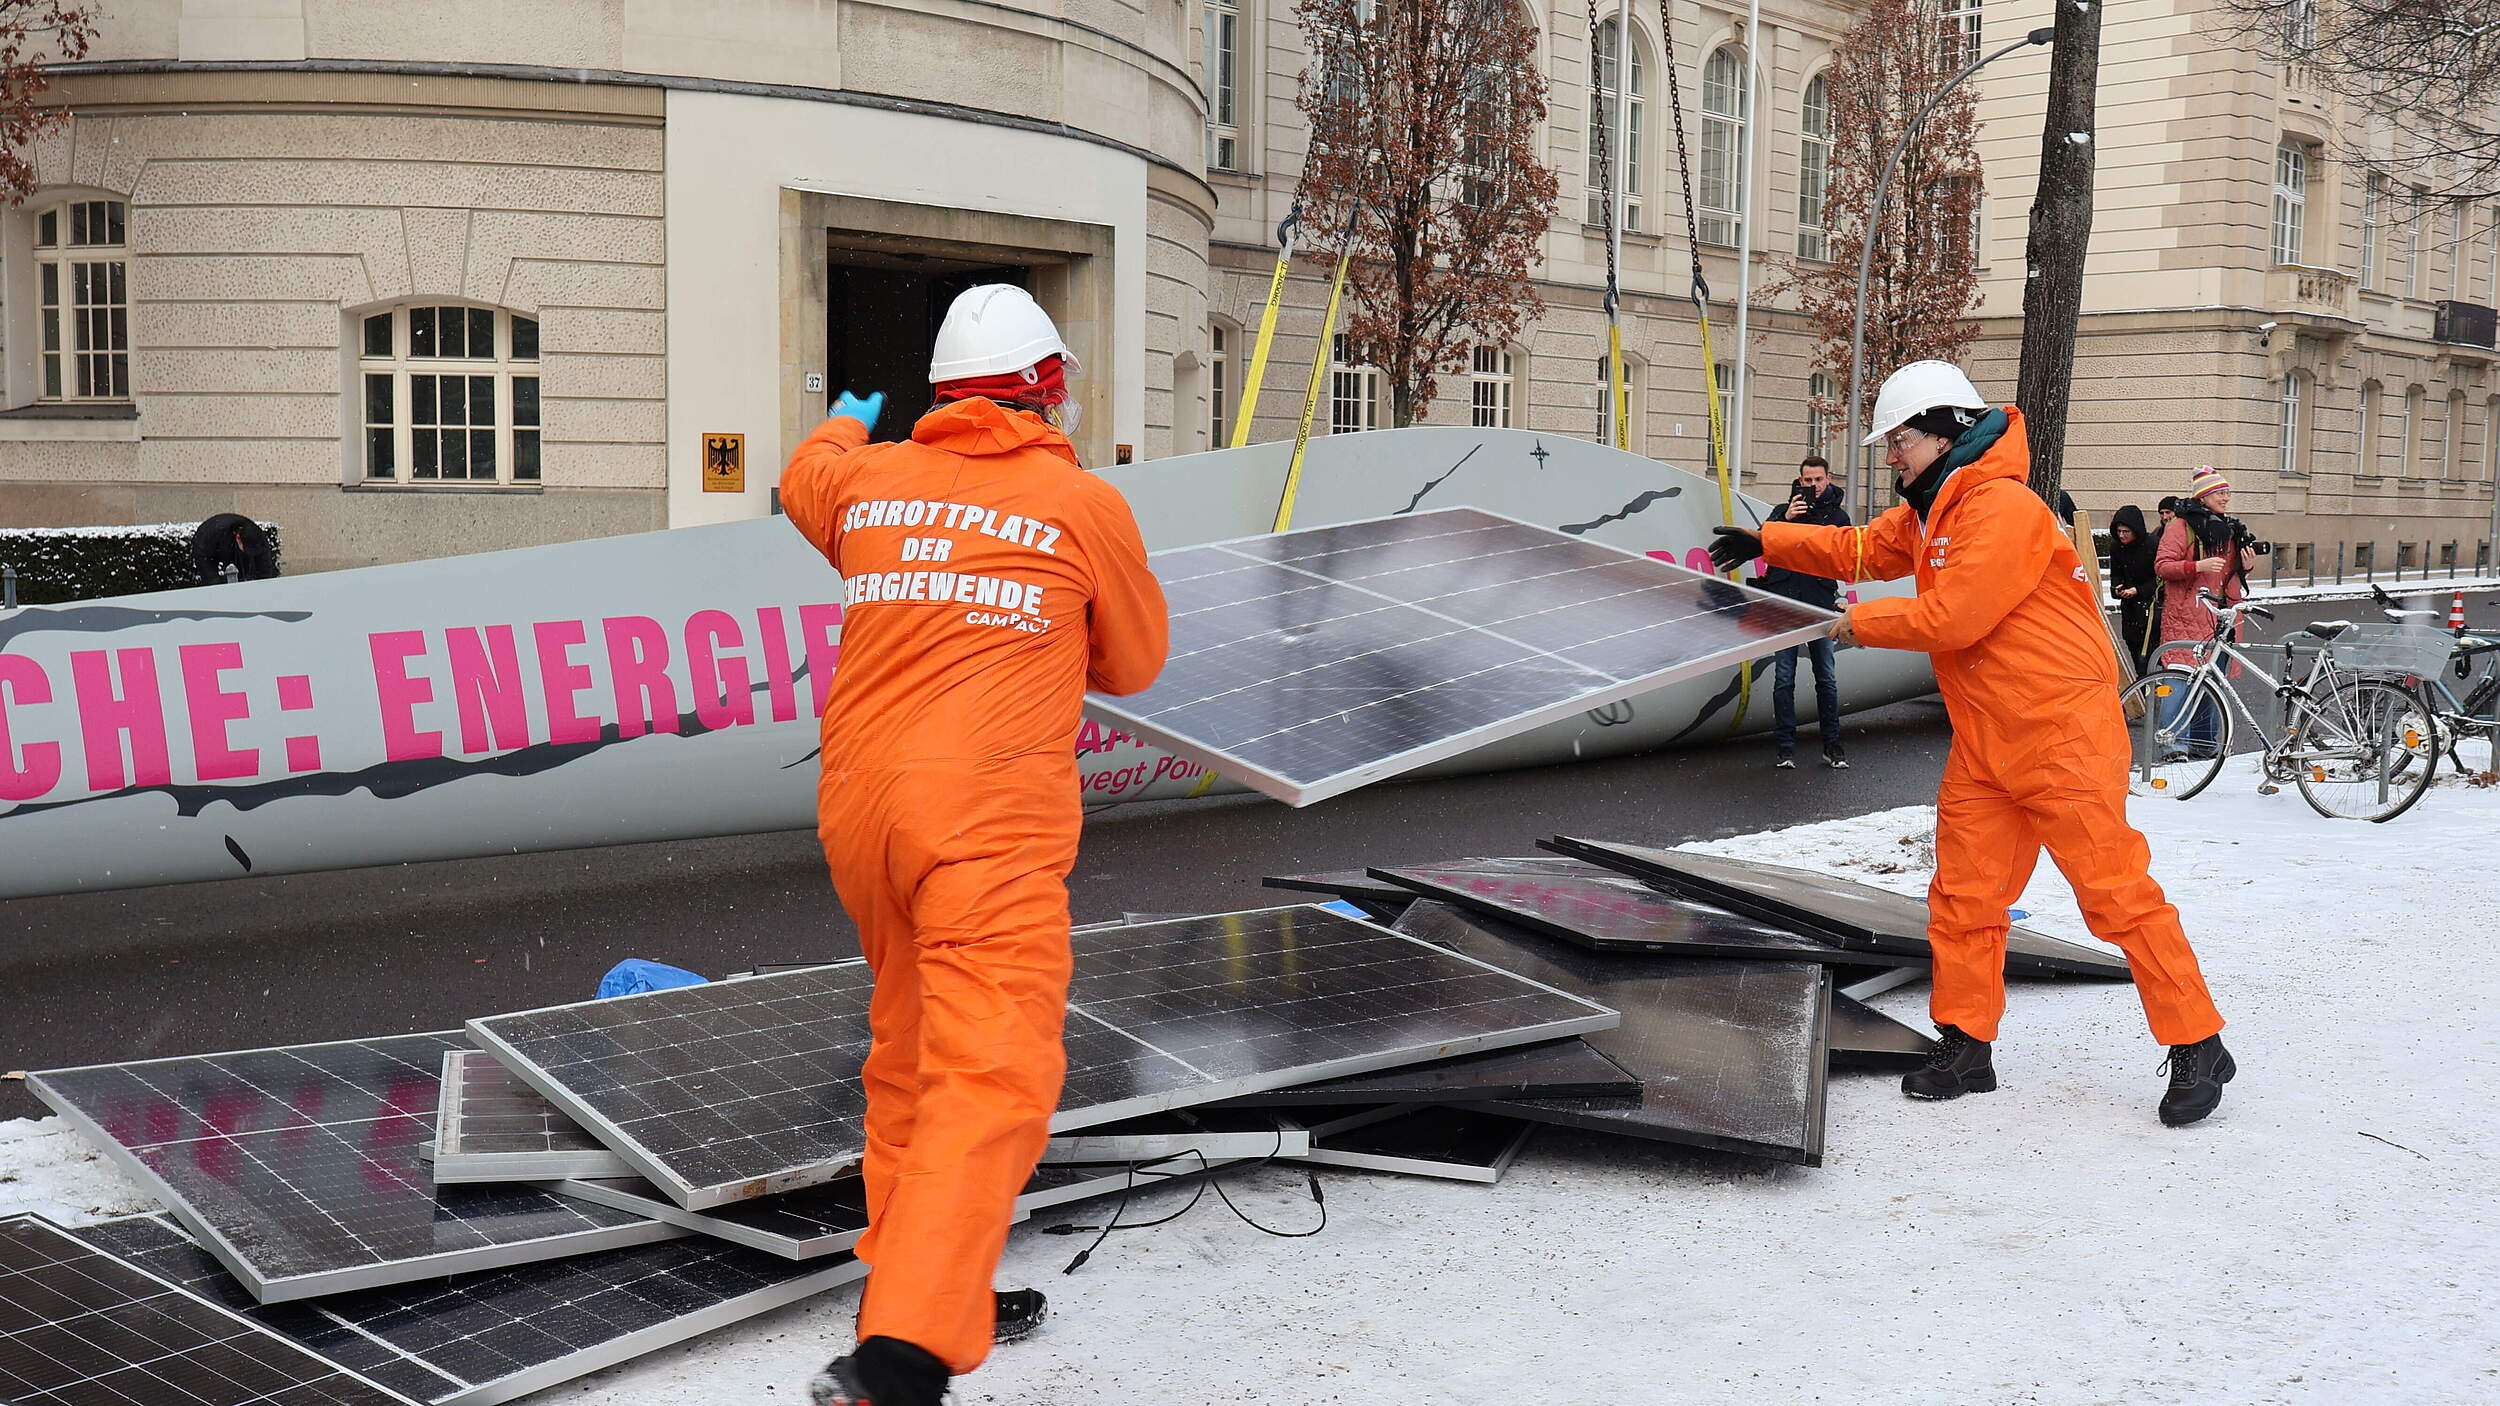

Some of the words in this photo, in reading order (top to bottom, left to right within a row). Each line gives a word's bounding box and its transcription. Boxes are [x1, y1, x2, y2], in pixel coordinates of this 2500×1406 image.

[809, 376, 821, 389] 37
[842, 499, 1062, 555] SCHROTTPLATZ
[900, 537, 953, 562] DER
